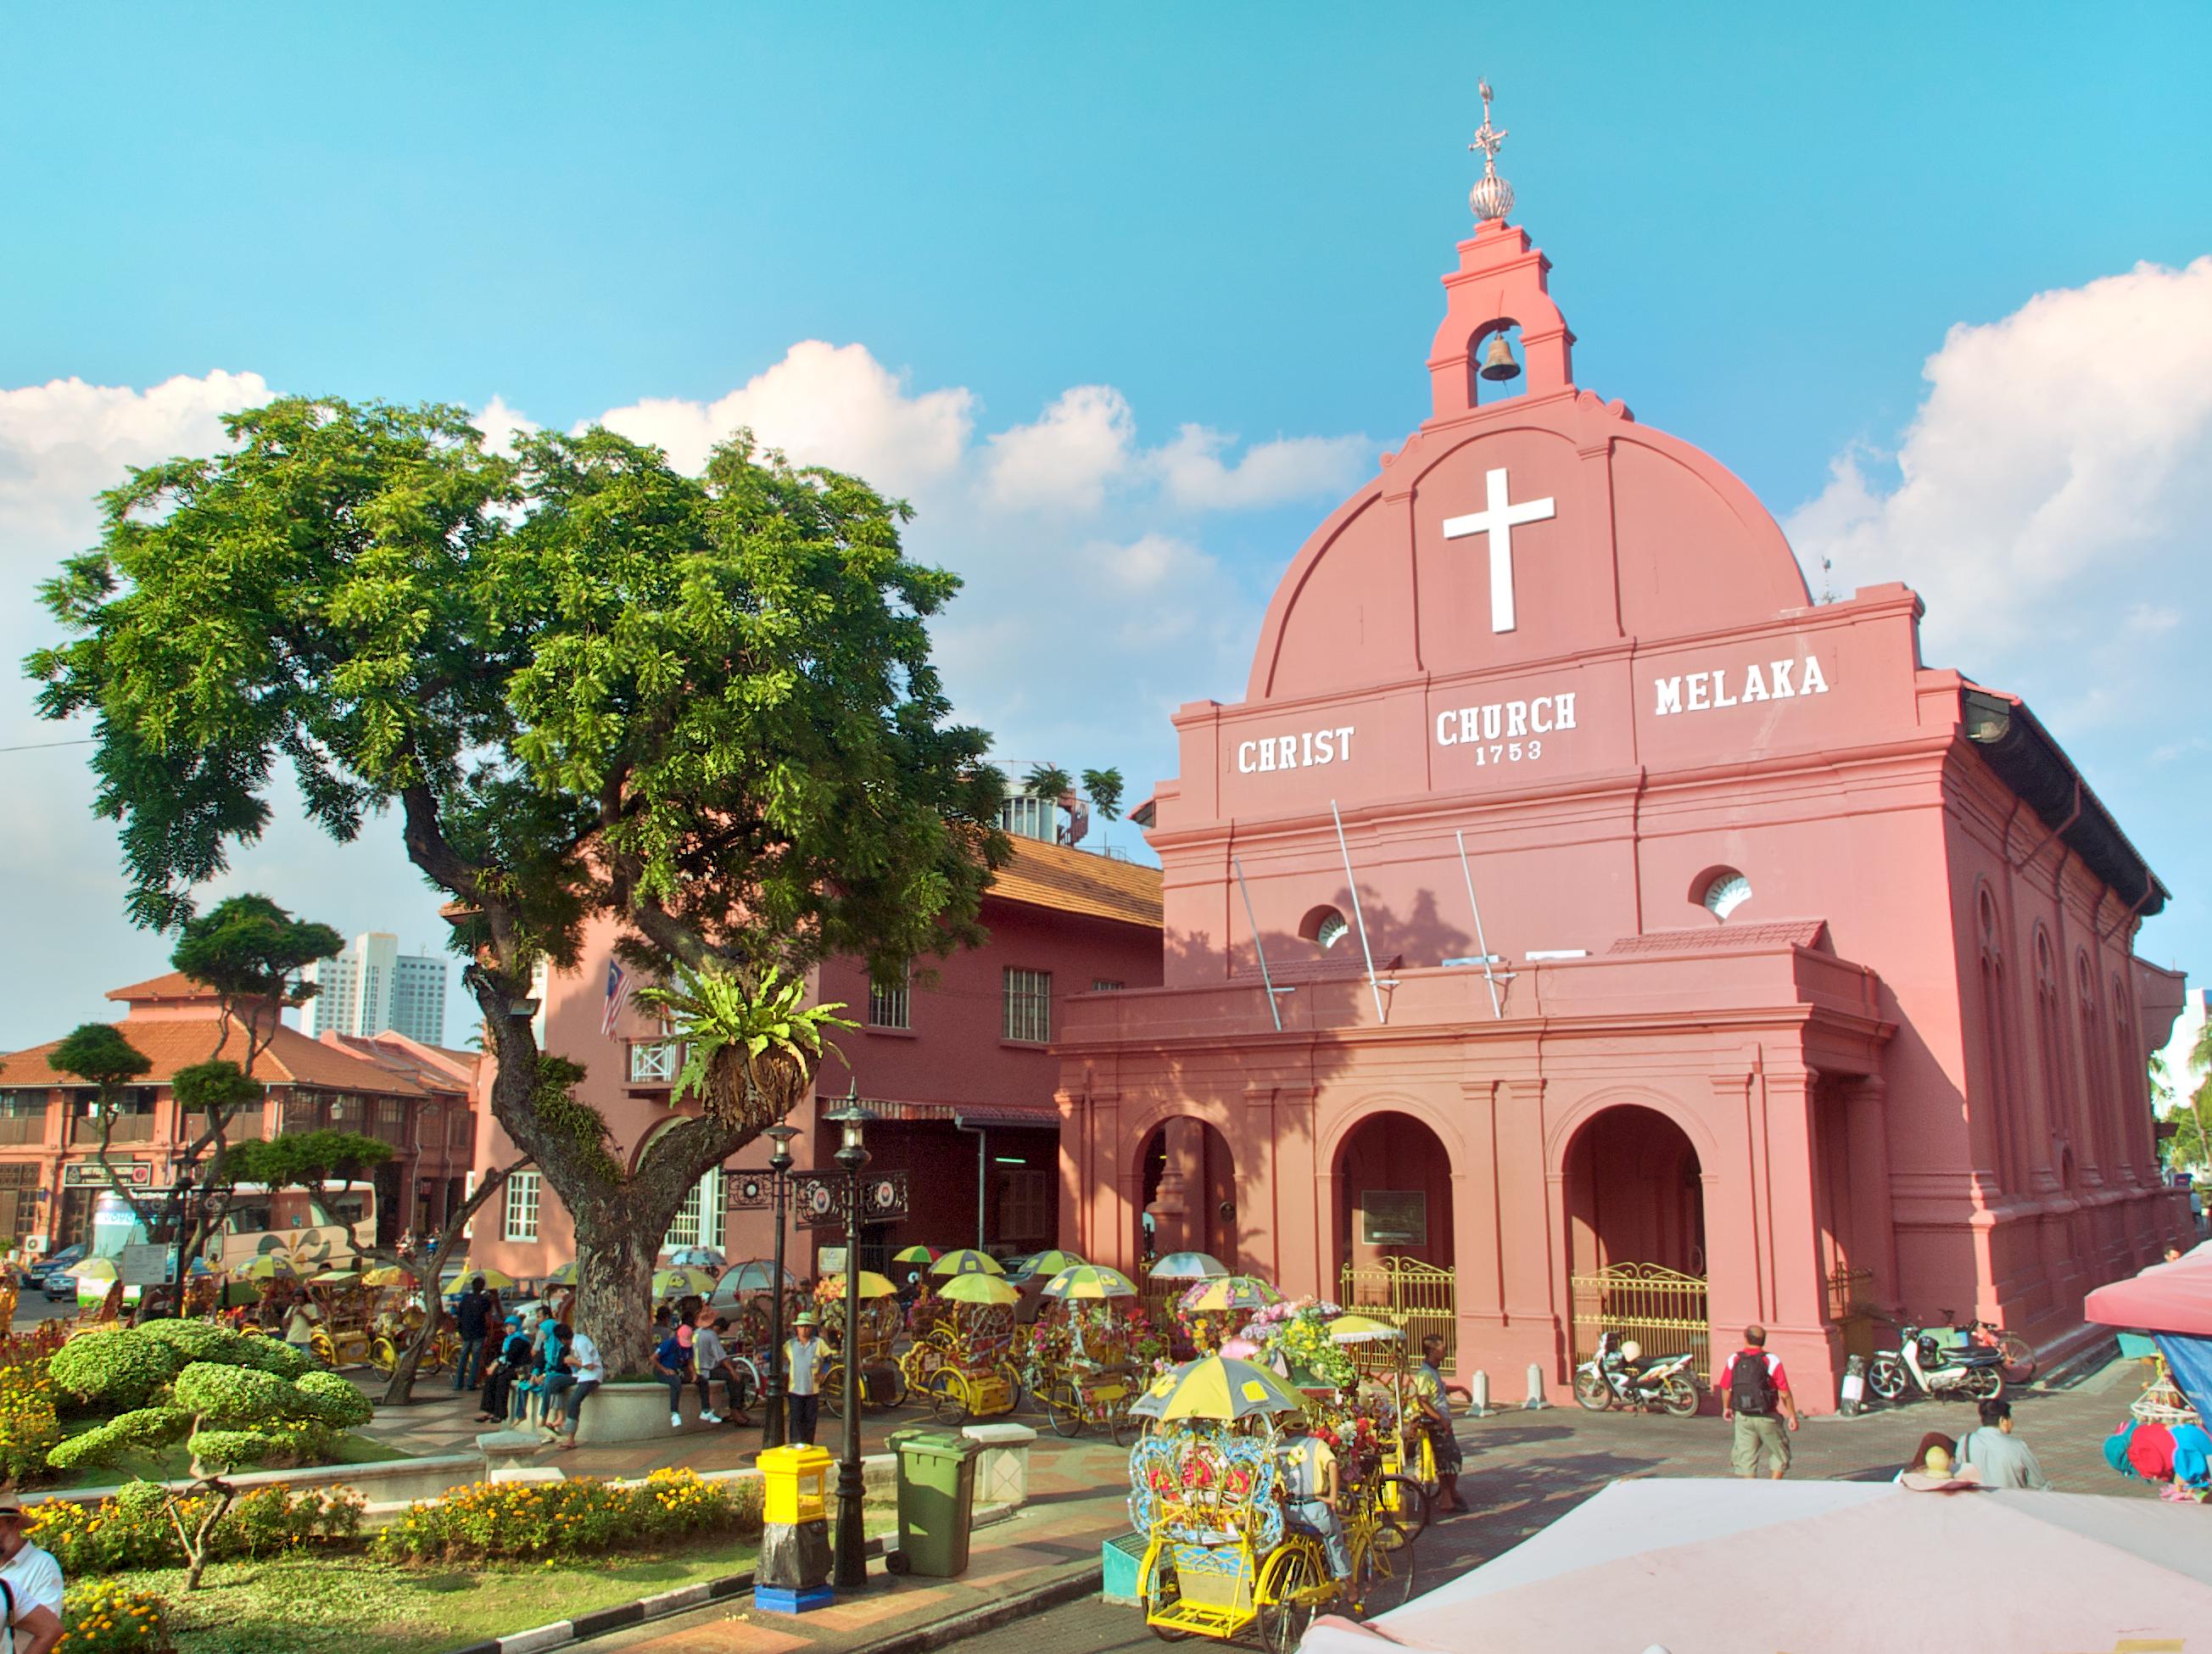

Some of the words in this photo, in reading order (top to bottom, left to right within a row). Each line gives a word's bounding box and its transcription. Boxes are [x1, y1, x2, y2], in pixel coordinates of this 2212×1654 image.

[1237, 726, 1355, 774] CHRIST
[1435, 692, 1578, 746] CHURCH
[1653, 655, 1830, 717] MELAKA
[1475, 740, 1542, 767] 1753
